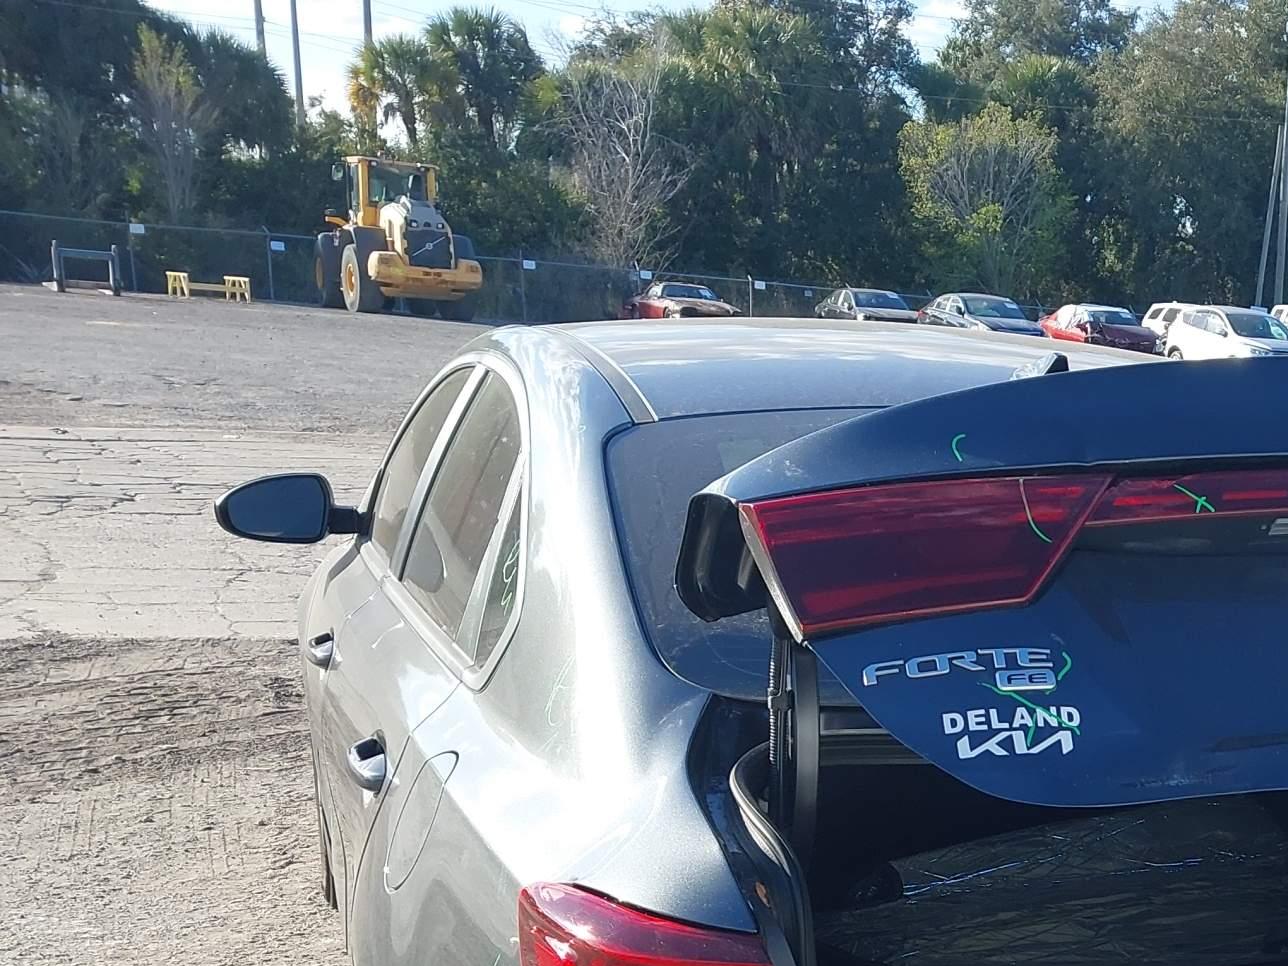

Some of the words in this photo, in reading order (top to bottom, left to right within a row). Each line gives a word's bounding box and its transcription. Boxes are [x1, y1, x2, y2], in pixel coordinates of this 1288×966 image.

[862, 646, 1054, 687] FORTE
[1006, 672, 1048, 685] FE
[942, 705, 1081, 734] DELAND
[956, 729, 1074, 760] KIA
